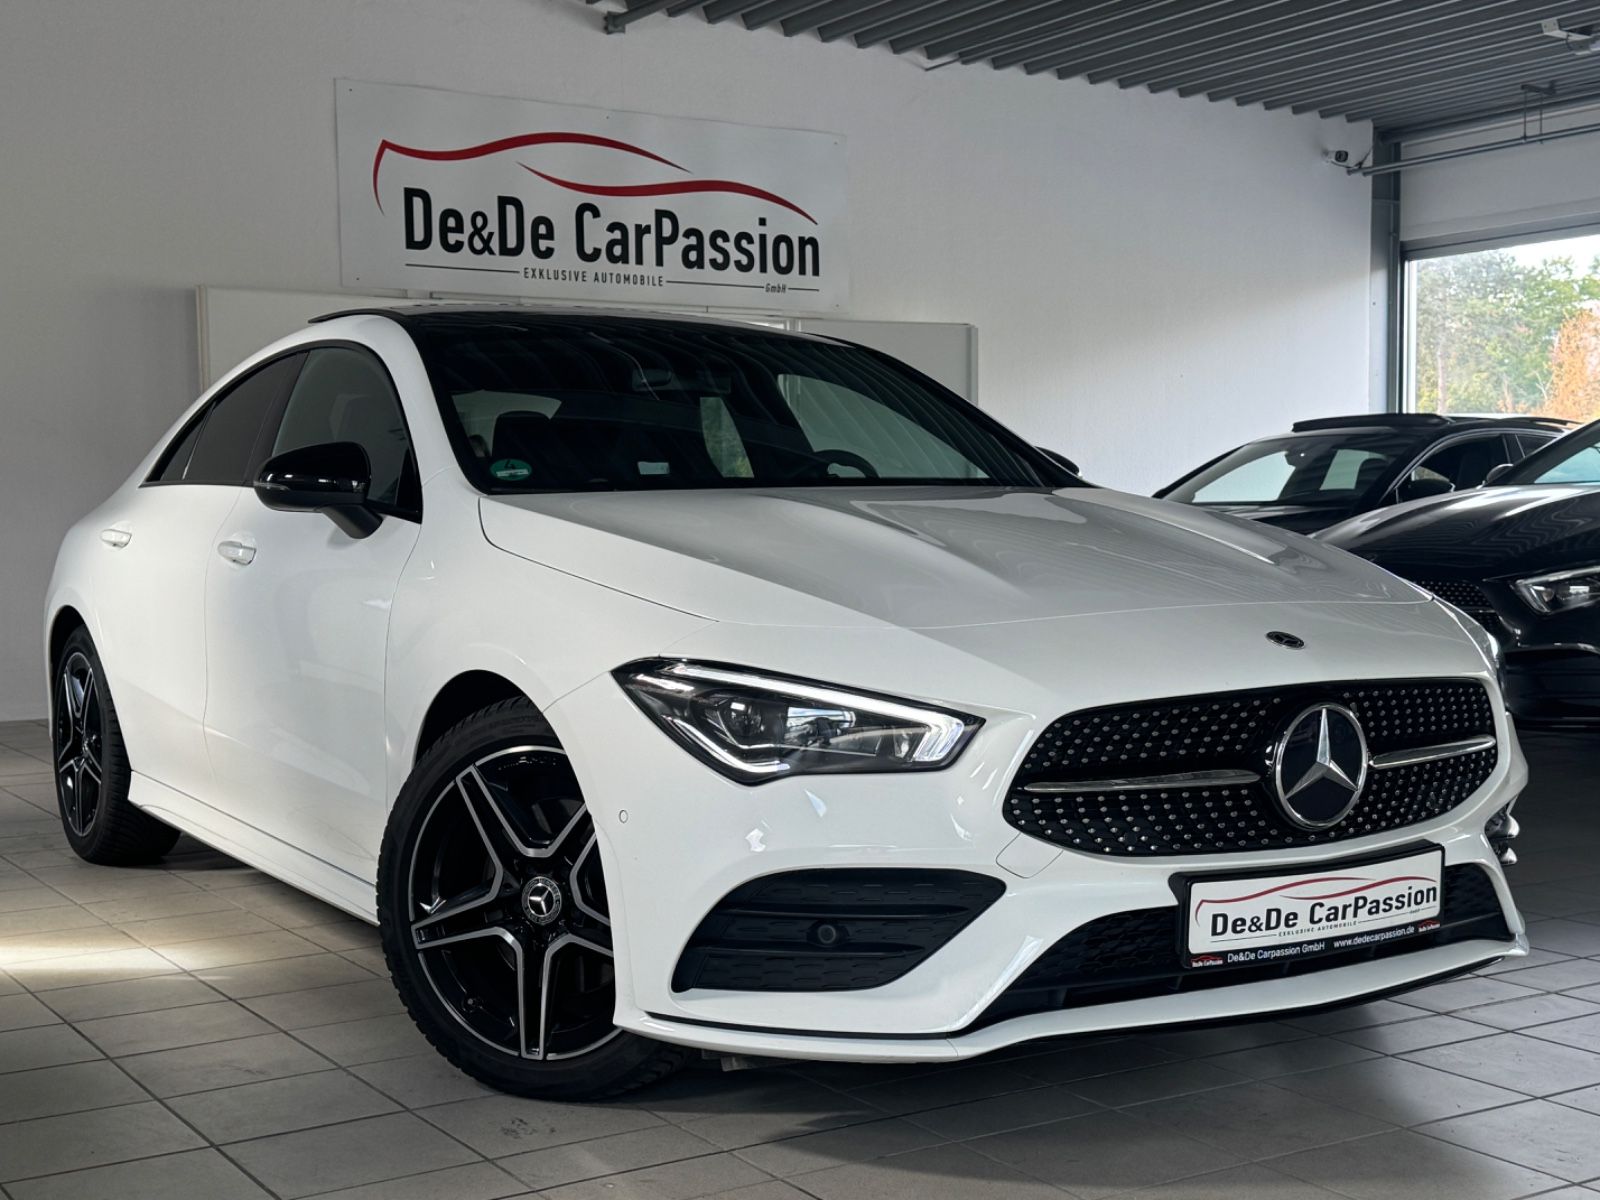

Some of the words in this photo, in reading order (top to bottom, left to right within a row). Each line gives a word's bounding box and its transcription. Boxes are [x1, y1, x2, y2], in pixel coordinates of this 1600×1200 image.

[403, 187, 555, 260] De&De
[575, 202, 820, 277] CarPassion
[523, 267, 587, 282] EXKLUSIVE
[593, 271, 664, 287] AUTOMOBILE
[765, 282, 787, 293] GmbH
[1210, 908, 1298, 937] De&De
[1309, 886, 1437, 925] CarPassion
[1227, 952, 1256, 963] De&De
[1257, 945, 1300, 960] Carpassion
[1301, 941, 1325, 953] GmbH
[1333, 925, 1415, 948] www.dedecarpassion.de
